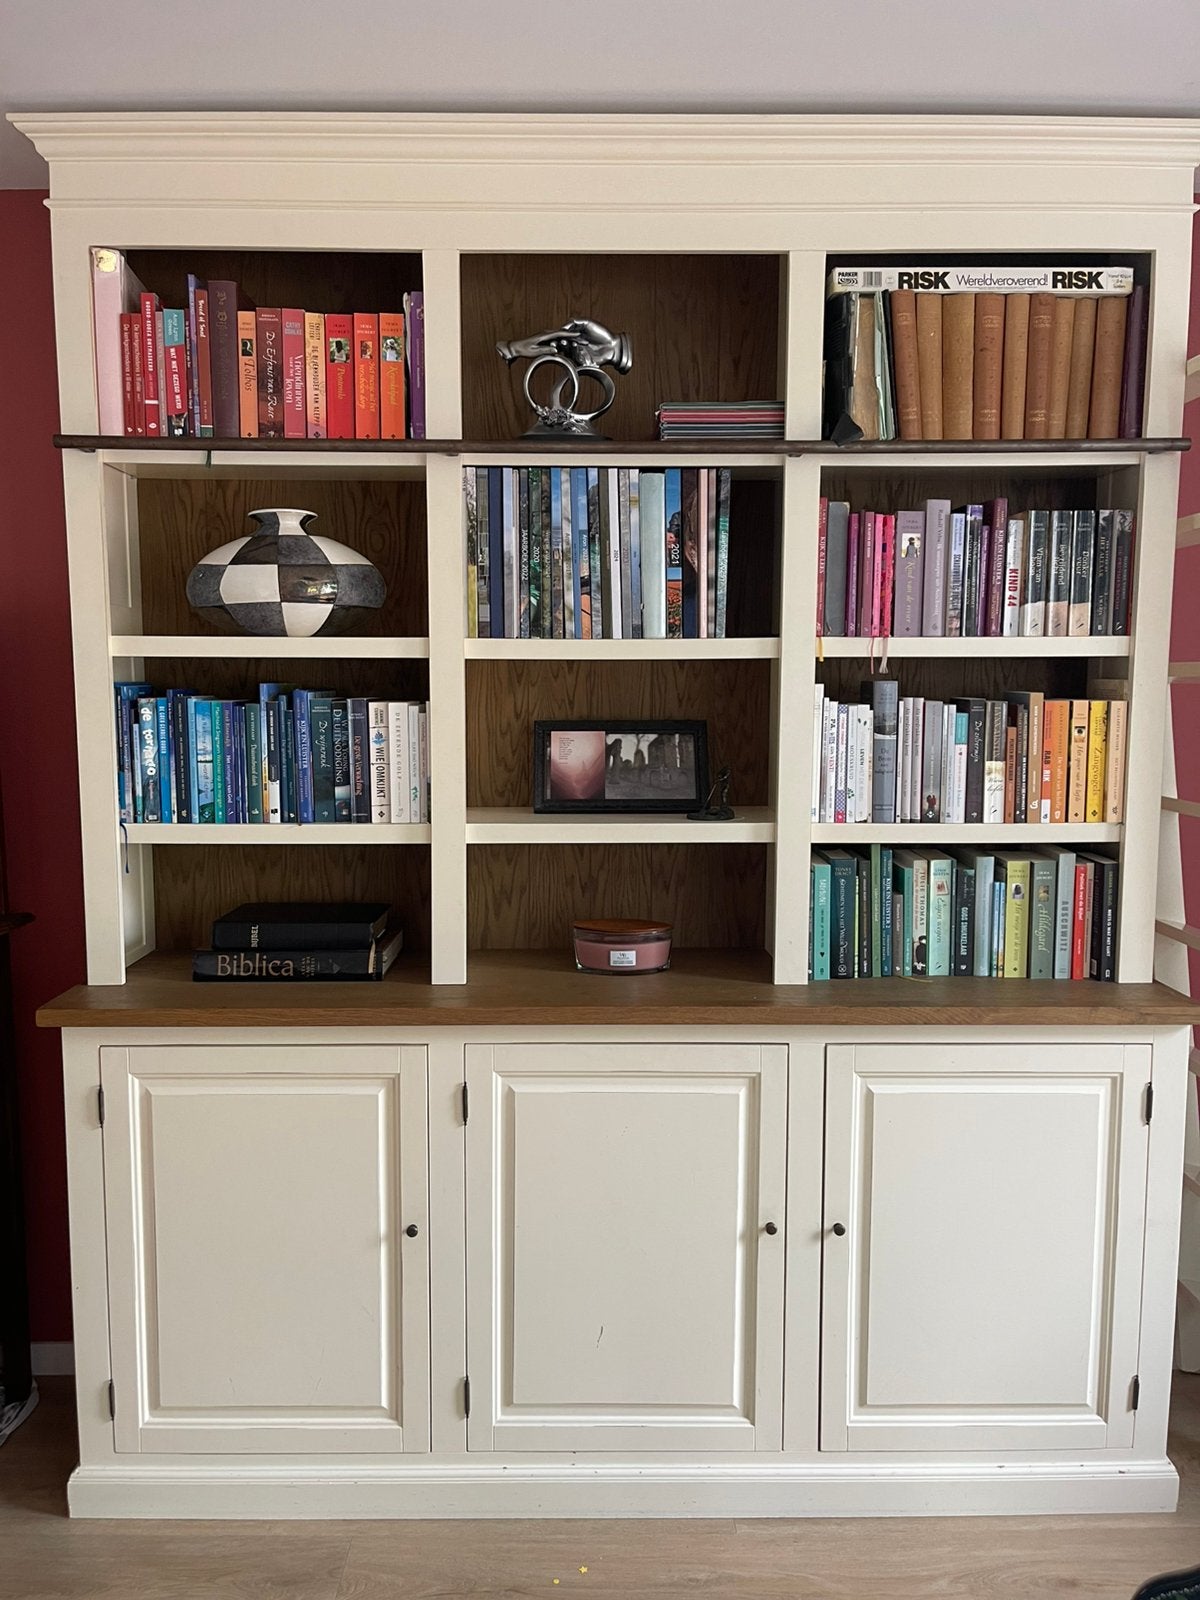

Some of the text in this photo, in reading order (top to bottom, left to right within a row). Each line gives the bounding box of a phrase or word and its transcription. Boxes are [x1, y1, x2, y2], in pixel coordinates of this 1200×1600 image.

[897, 271, 1104, 290] RISK Wereldveroverend! RISK
[123, 332, 131, 372] kerkgeschiedenis
[133, 332, 141, 372] kerkgeschiedenis
[311, 345, 319, 353] DE
[172, 373, 180, 393] GEZEGD
[244, 358, 255, 392] Tolbos
[263, 331, 277, 419] De Erfenis van Rose
[294, 354, 304, 411] Vriendinnen
[174, 394, 182, 409] WERD
[285, 378, 294, 403] leven
[671, 543, 680, 565] 2021
[997, 544, 1004, 553] EN
[1036, 547, 1044, 567] Vlam
[521, 565, 529, 581] 2022
[905, 561, 916, 578] Kind
[996, 554, 1004, 580] LUISTER
[1057, 544, 1067, 585] Bevrijdend
[1081, 550, 1090, 578] Donker
[906, 595, 914, 604] de
[1007, 568, 1019, 607] KIND 44
[933, 587, 941, 616] Auschwitz
[318, 720, 328, 733] De
[395, 712, 401, 721] DE
[141, 707, 157, 776] de tornado
[300, 734, 307, 743] EN
[315, 734, 331, 768] wijnrank
[333, 709, 343, 783] DE UITNODIGING
[970, 720, 983, 763] De zilvermijn
[1076, 745, 1084, 757] Het
[375, 746, 386, 799] WIE OMKIJKT
[1091, 746, 1103, 796] Zangvogels
[885, 891, 891, 900] EN
[935, 897, 947, 943] Eigen wegen
[1014, 902, 1023, 915] Het
[251, 924, 260, 948] BIJBEL
[1034, 903, 1052, 954] Hildegard
[1059, 900, 1069, 953] AUSCHWITZ
[216, 952, 294, 977] Biblica
